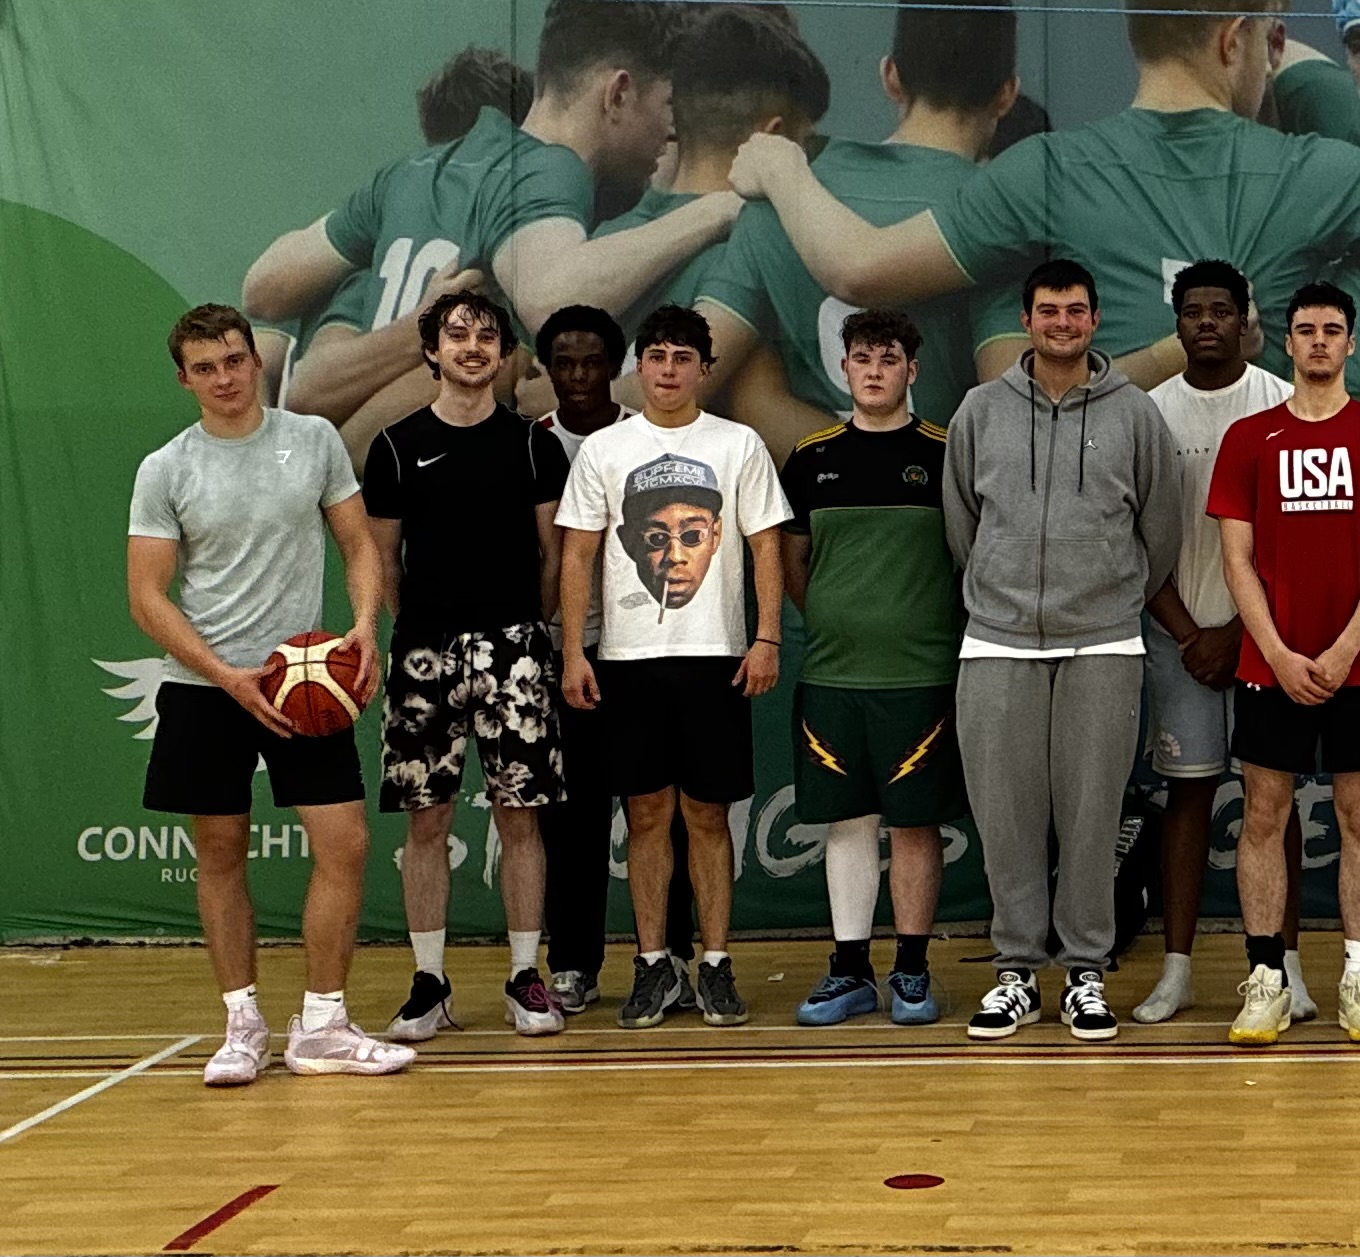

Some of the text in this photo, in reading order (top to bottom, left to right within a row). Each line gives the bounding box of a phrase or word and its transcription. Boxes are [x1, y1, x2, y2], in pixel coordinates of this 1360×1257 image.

[633, 462, 706, 484] SUPREME
[1279, 446, 1354, 498] USA
[1283, 501, 1351, 511] BASKETBALL
